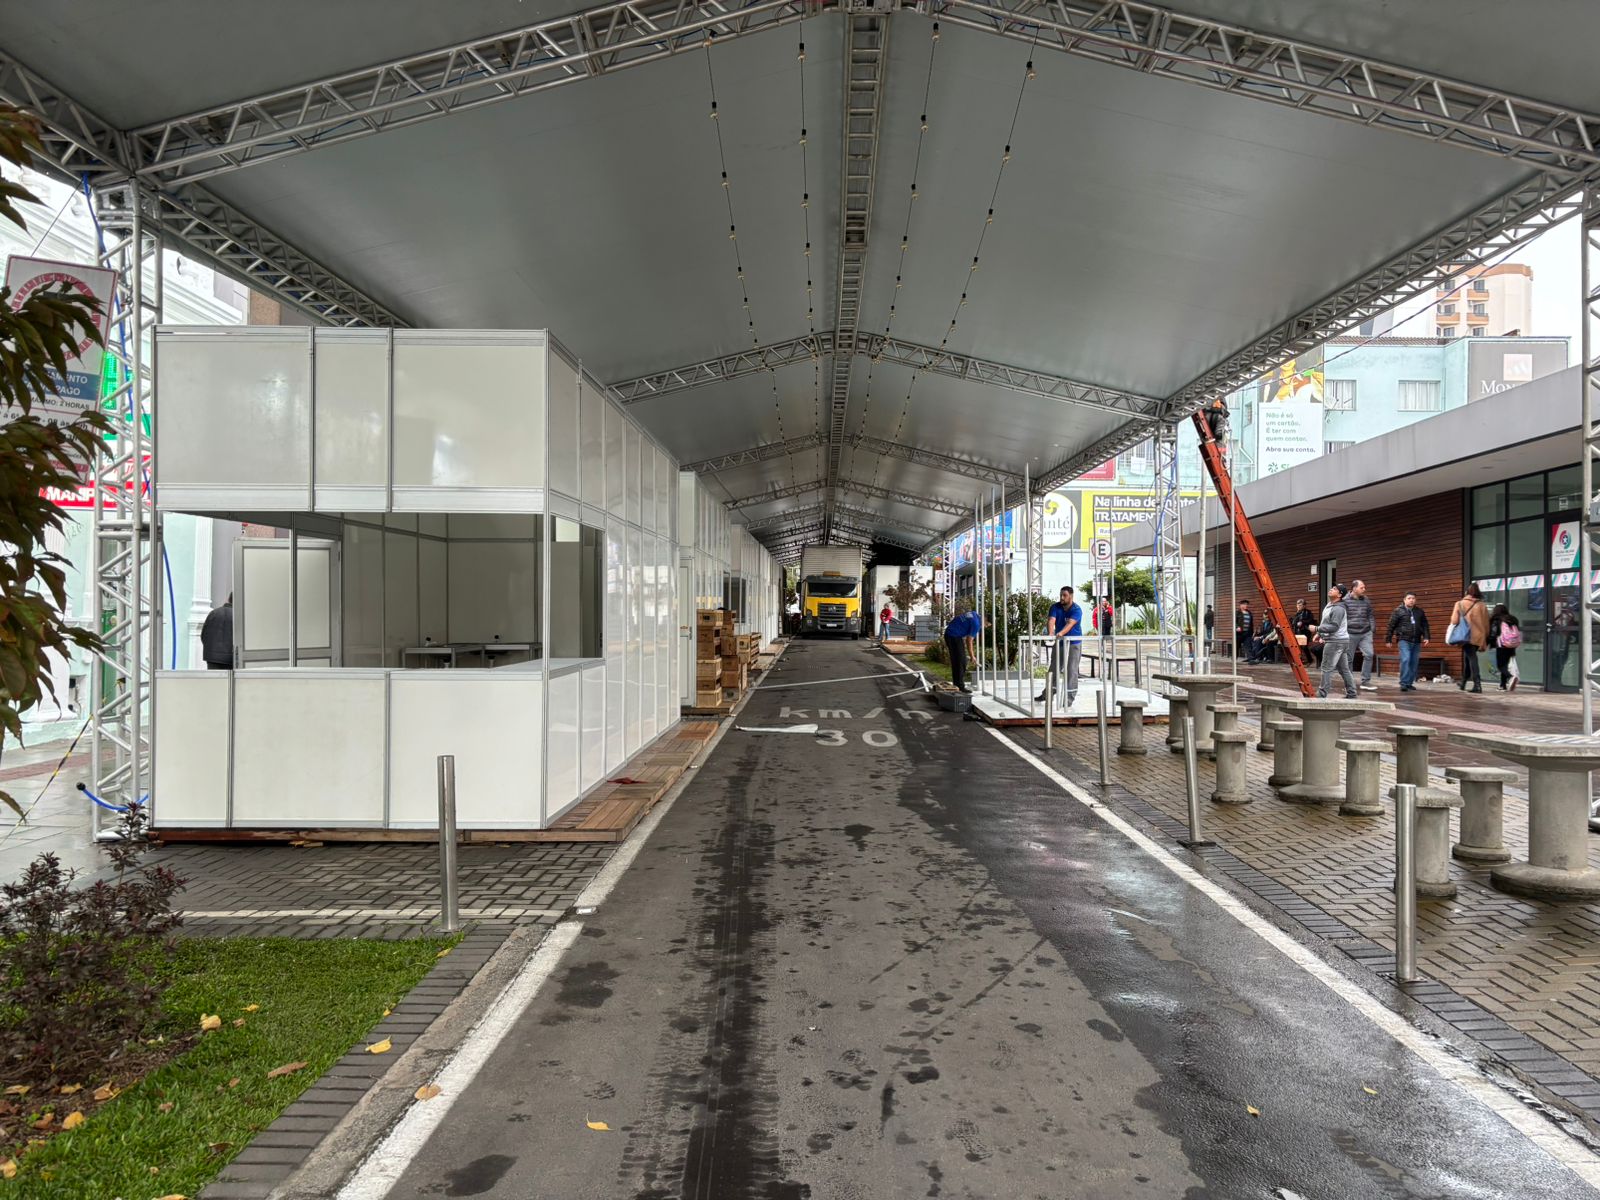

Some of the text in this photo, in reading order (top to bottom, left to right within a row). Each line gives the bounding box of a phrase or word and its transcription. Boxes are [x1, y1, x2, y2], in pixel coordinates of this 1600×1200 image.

[65, 401, 89, 410] HORAS
[1094, 496, 1110, 507] Na
[1114, 496, 1141, 507] linha
[1144, 496, 1157, 508] de
[1098, 544, 1106, 556] E
[779, 706, 933, 720] km/h
[816, 730, 898, 746] 30
